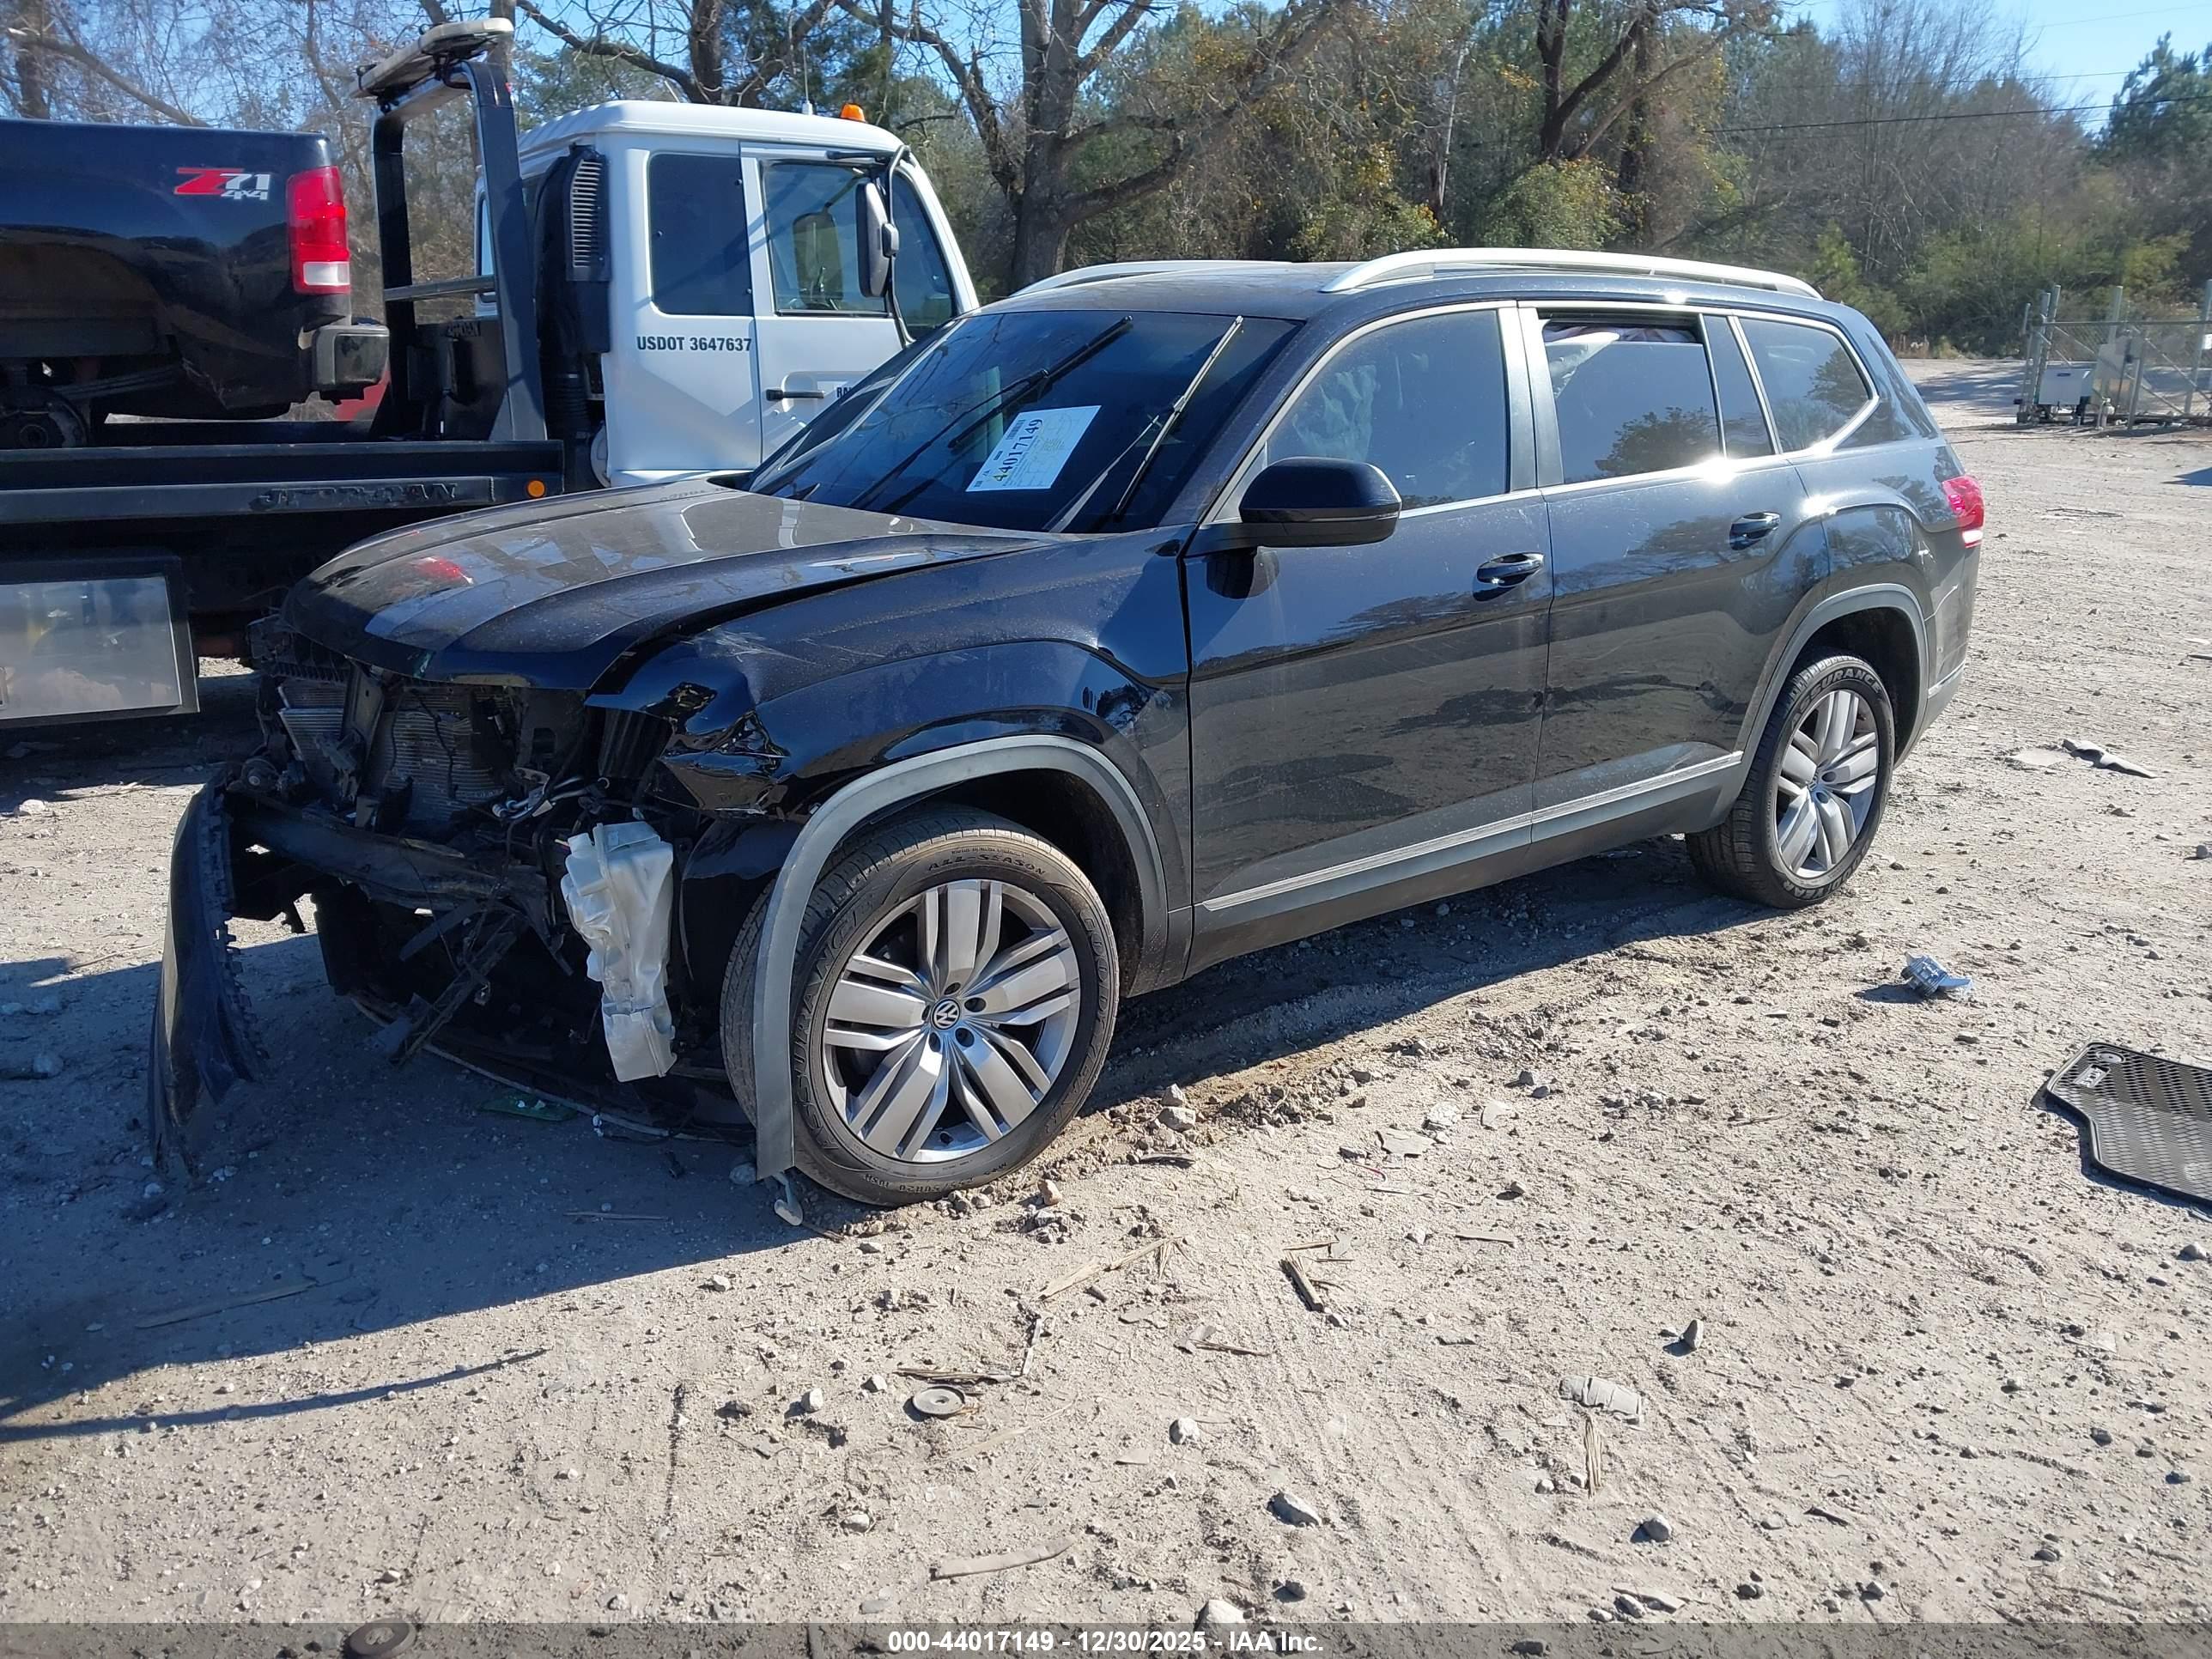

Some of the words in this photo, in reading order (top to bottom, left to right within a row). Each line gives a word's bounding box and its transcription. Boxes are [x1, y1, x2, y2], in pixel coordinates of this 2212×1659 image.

[174, 167, 270, 195] Z71
[636, 336, 685, 350] USDOT
[689, 337, 752, 351] 3647637
[992, 418, 1043, 482] 44017149
[1791, 668, 1881, 731] ASSURANCE
